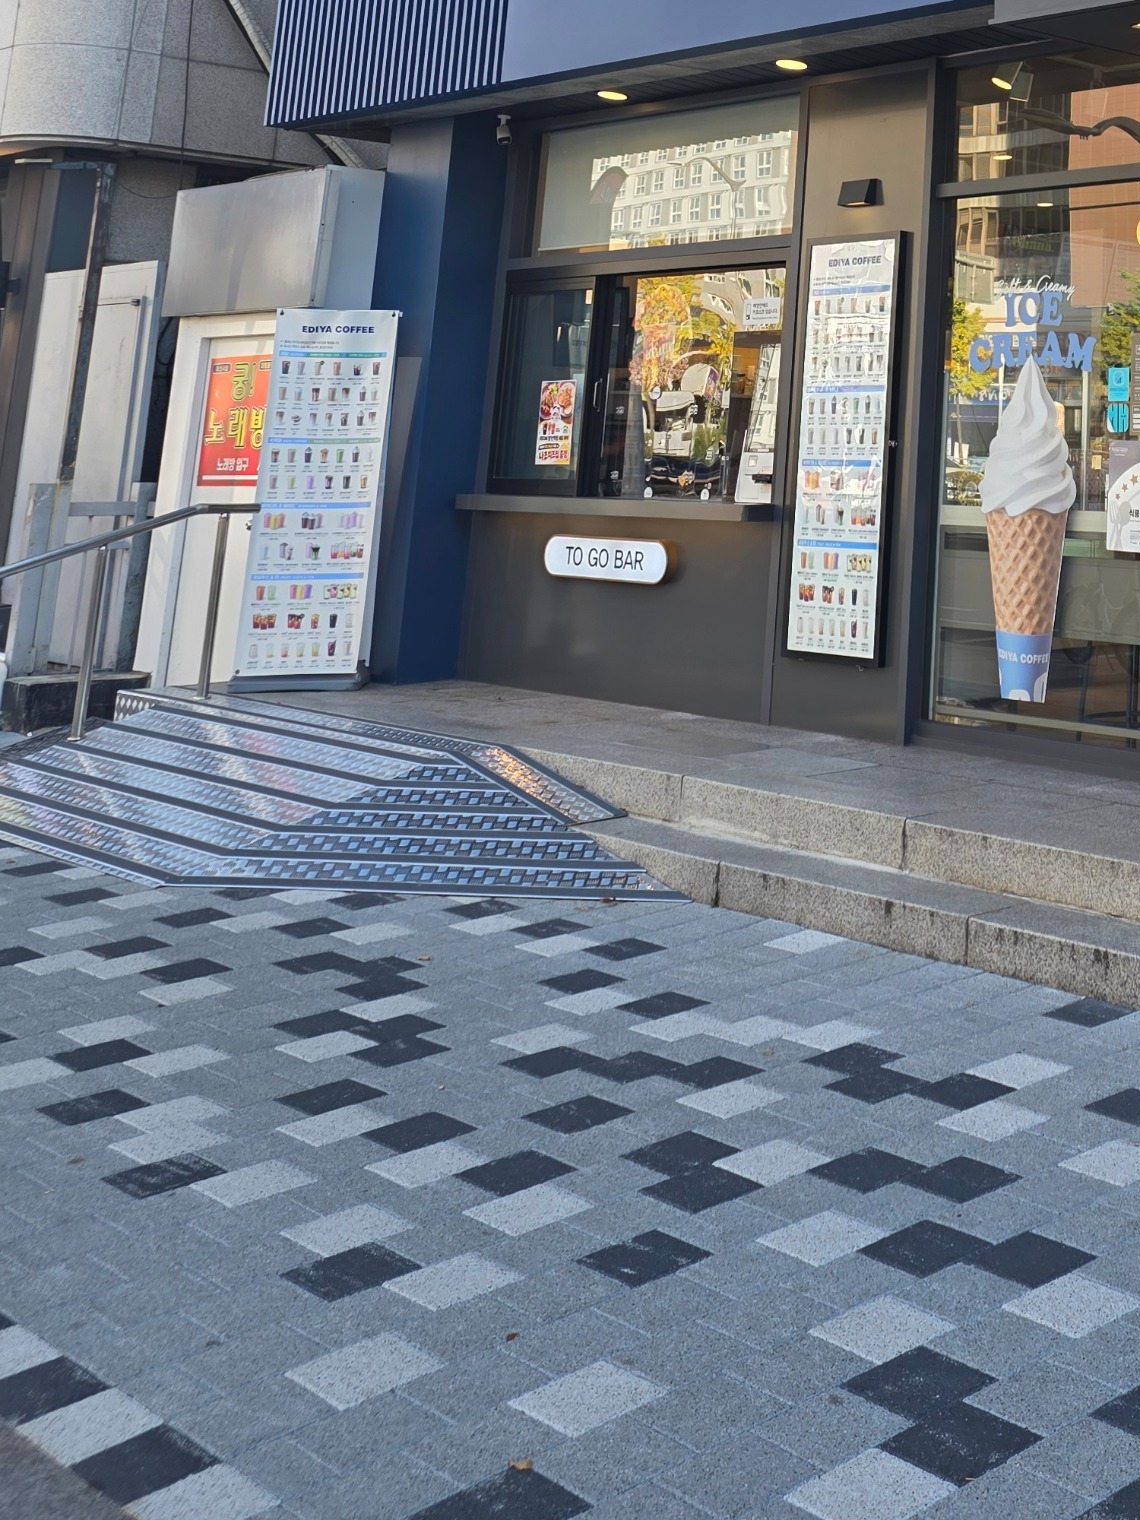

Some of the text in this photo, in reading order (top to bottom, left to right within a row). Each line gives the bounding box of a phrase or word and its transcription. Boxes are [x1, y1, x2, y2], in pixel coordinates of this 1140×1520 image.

[828, 255, 882, 268] EDIYA COFFEE
[1033, 274, 1076, 301] Creamy
[1005, 291, 1064, 328] ICE
[302, 325, 375, 334] EDIYA COFFEE
[968, 330, 1097, 373] CREAM
[204, 406, 267, 449] 노래방
[565, 546, 645, 571] TO GO BAR
